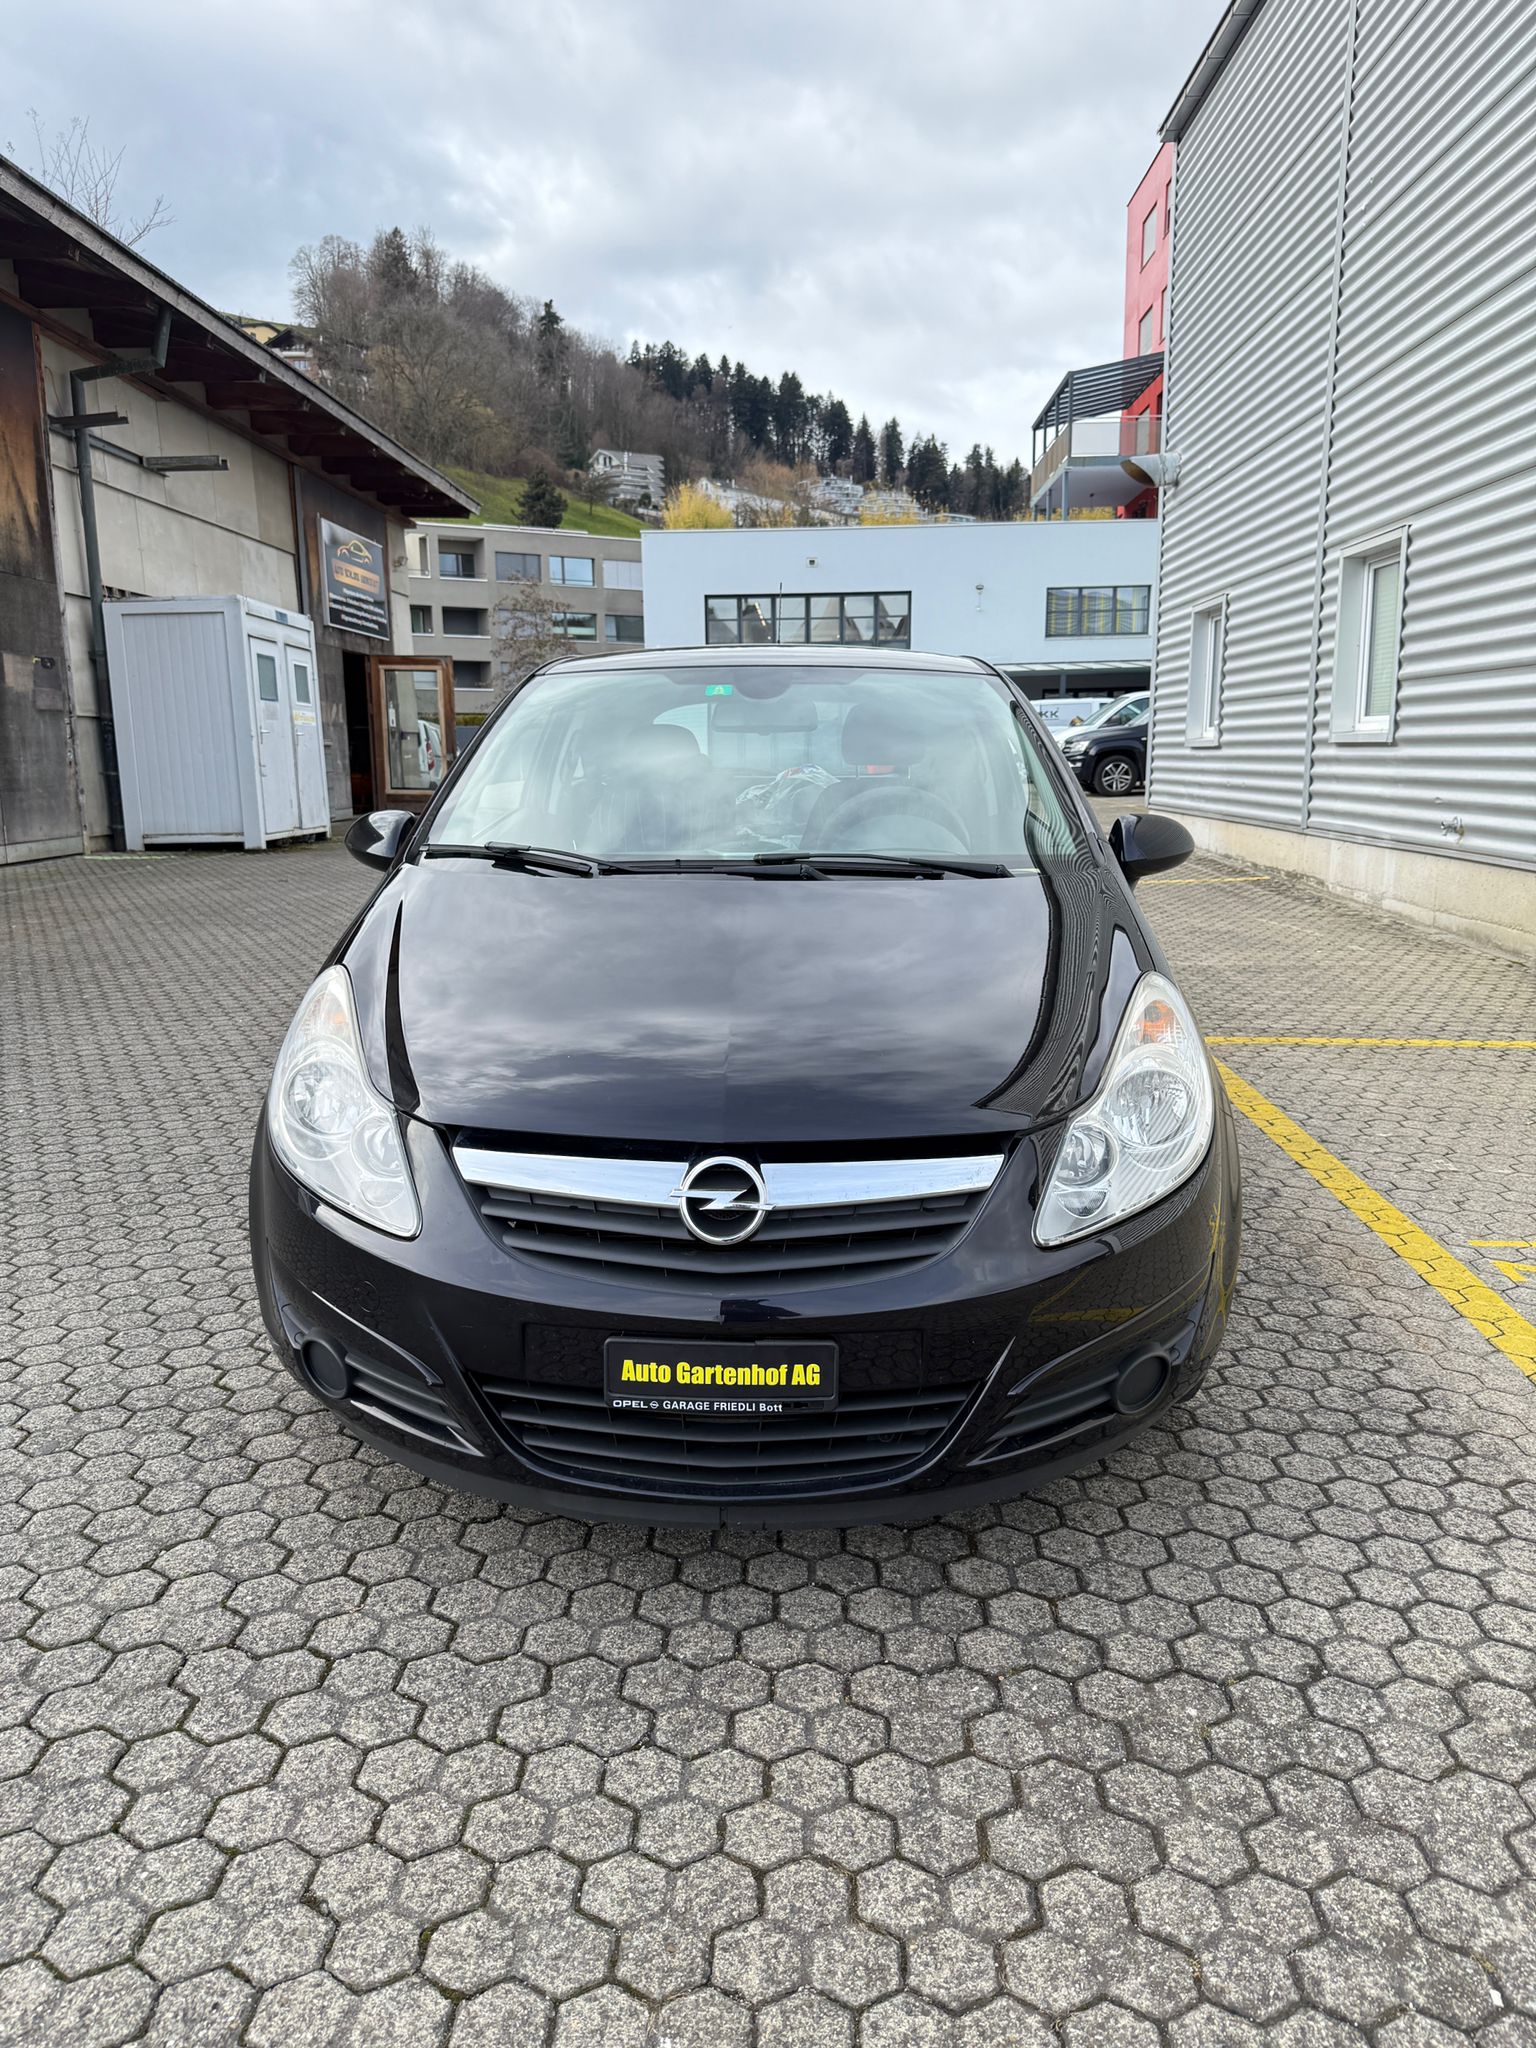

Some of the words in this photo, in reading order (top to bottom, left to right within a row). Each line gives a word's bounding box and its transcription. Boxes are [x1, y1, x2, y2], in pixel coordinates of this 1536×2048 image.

[621, 1359, 671, 1383] Auto
[676, 1361, 788, 1386] Gartenhof
[791, 1363, 821, 1386] AG
[612, 1400, 648, 1409] OPEL
[662, 1400, 710, 1411] GARAGE
[713, 1402, 756, 1412] FRIEDLI
[759, 1403, 783, 1412] Bott
